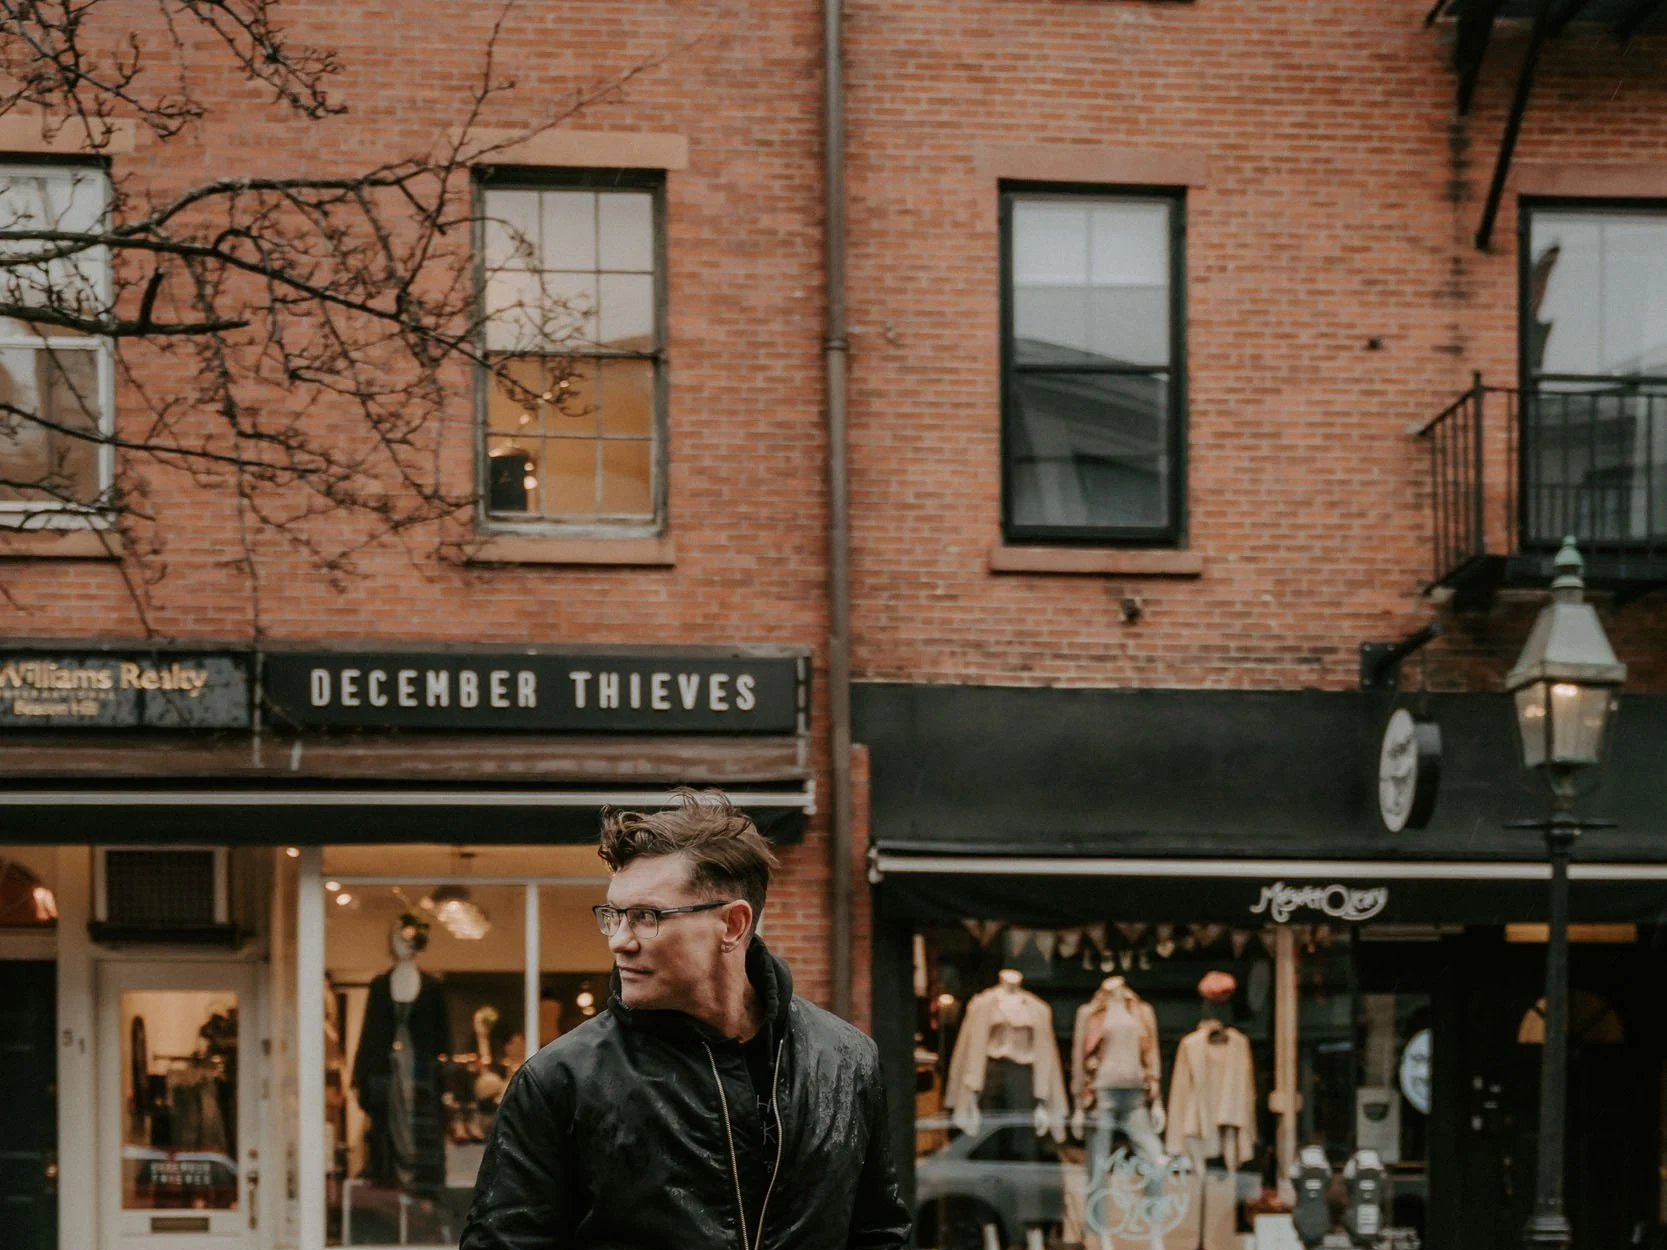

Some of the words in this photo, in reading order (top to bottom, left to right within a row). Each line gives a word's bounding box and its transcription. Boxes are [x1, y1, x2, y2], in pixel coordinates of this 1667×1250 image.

[119, 660, 208, 698] Realty
[311, 668, 536, 708] DECEMBER
[569, 671, 756, 711] THIEVES
